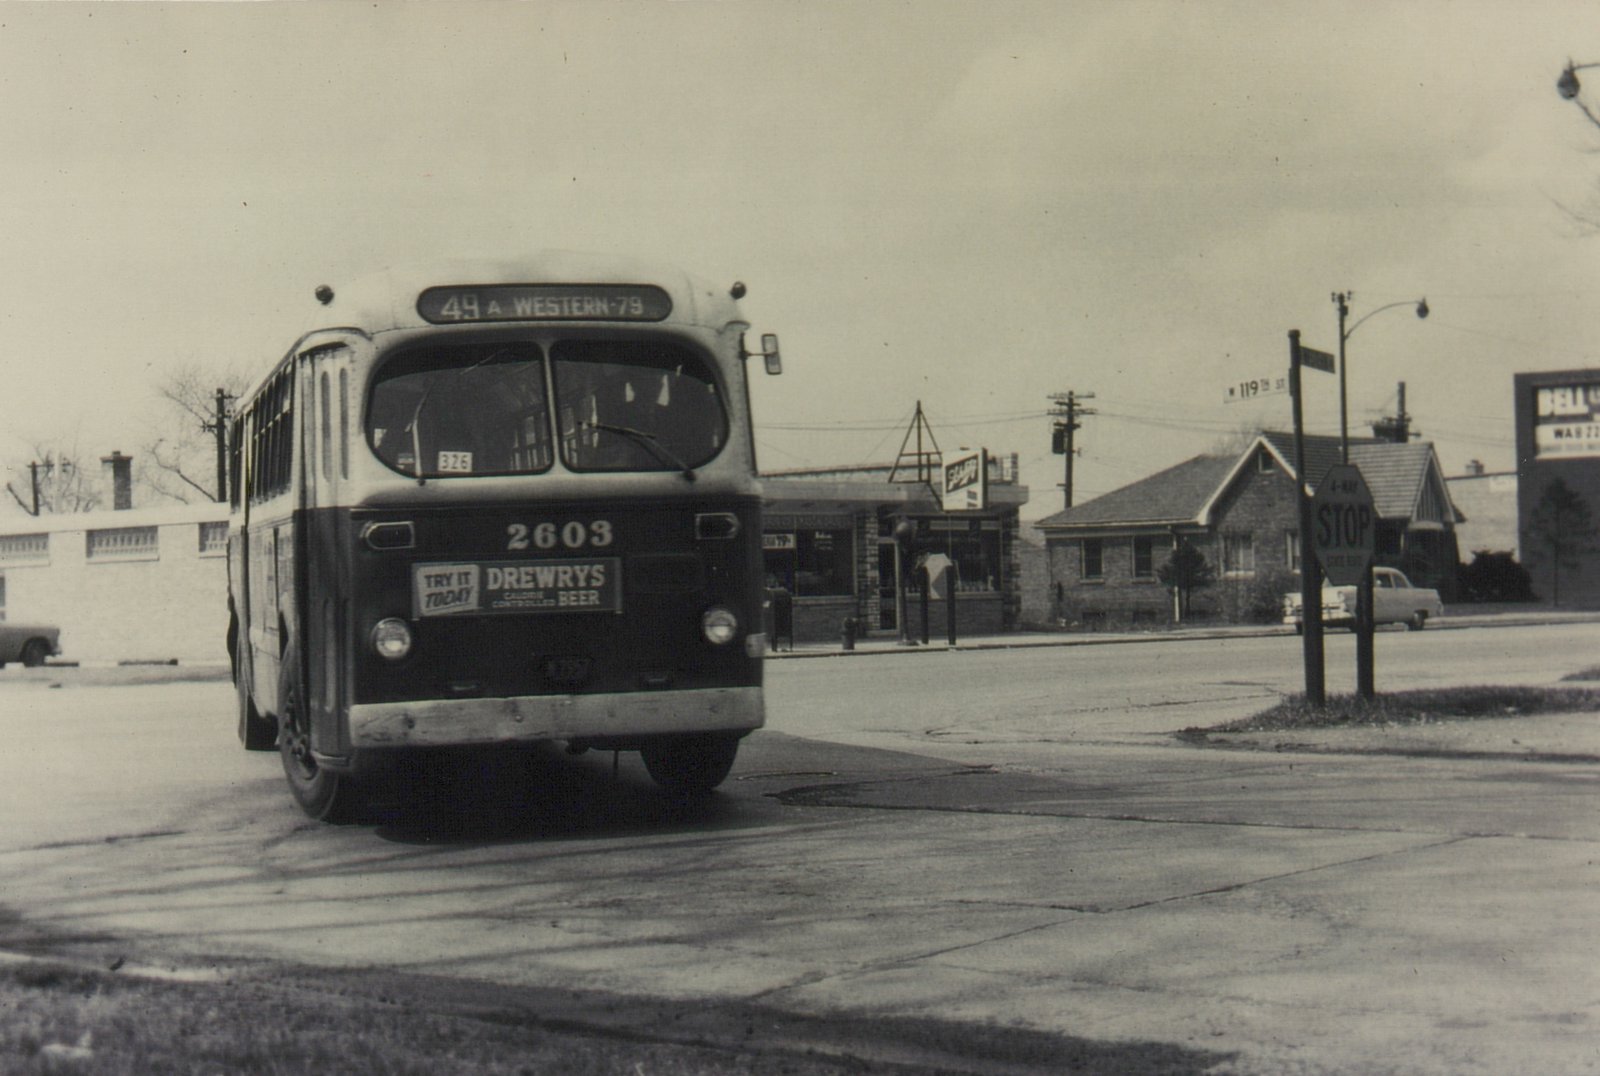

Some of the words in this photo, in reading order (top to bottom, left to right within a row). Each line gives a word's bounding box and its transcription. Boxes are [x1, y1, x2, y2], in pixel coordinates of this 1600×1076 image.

[440, 295, 479, 319] 49
[487, 301, 500, 315] A
[441, 453, 469, 469] 326
[507, 520, 613, 549] 2603
[1319, 503, 1370, 548] STOP
[424, 573, 449, 588] TRY
[457, 571, 471, 586] IT
[486, 564, 605, 590] DREWRYS
[425, 586, 473, 609] TODAY
[557, 590, 600, 606] BEER
